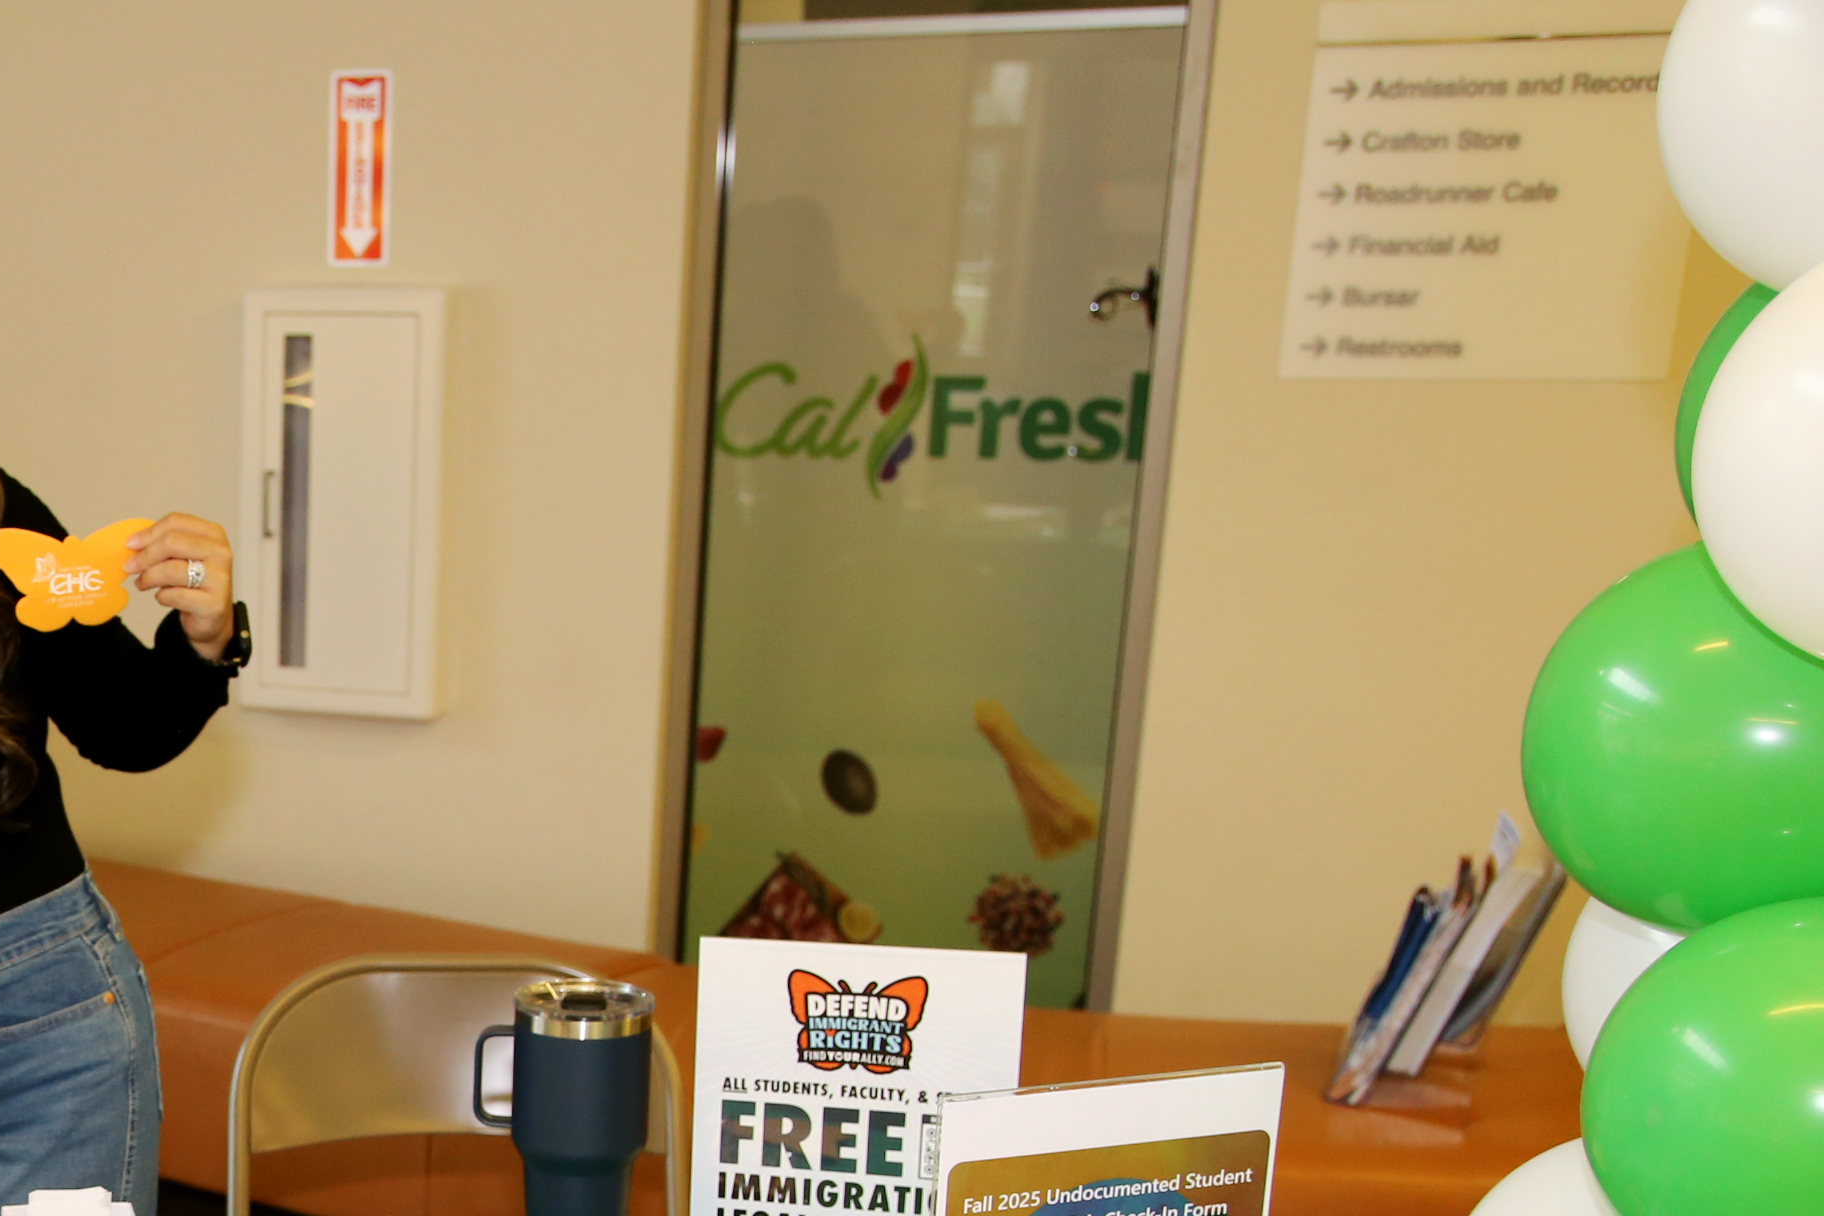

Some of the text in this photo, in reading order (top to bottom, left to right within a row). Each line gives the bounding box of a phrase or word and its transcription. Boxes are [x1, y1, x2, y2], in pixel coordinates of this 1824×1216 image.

[1368, 71, 1660, 99] Admissions and Record
[1360, 129, 1521, 152] Crafton Store
[1354, 181, 1559, 204] Roadrunner Cafe
[1348, 234, 1501, 256] Financial Aid
[1341, 288, 1419, 308] Bursar
[1336, 338, 1463, 357] Restrooms
[806, 993, 909, 1021] DEFEND
[809, 1017, 905, 1035] IMMIGRANT
[803, 1050, 906, 1068] FINDYOURALLY.COM
[723, 1077, 748, 1091] ALL
[754, 1079, 834, 1099] STUDENTS,
[841, 1085, 910, 1105] FACULTY,
[917, 1091, 928, 1103] &
[719, 1099, 907, 1177] FREE
[963, 1167, 1253, 1215] Fall 2025 Undocumented Student
